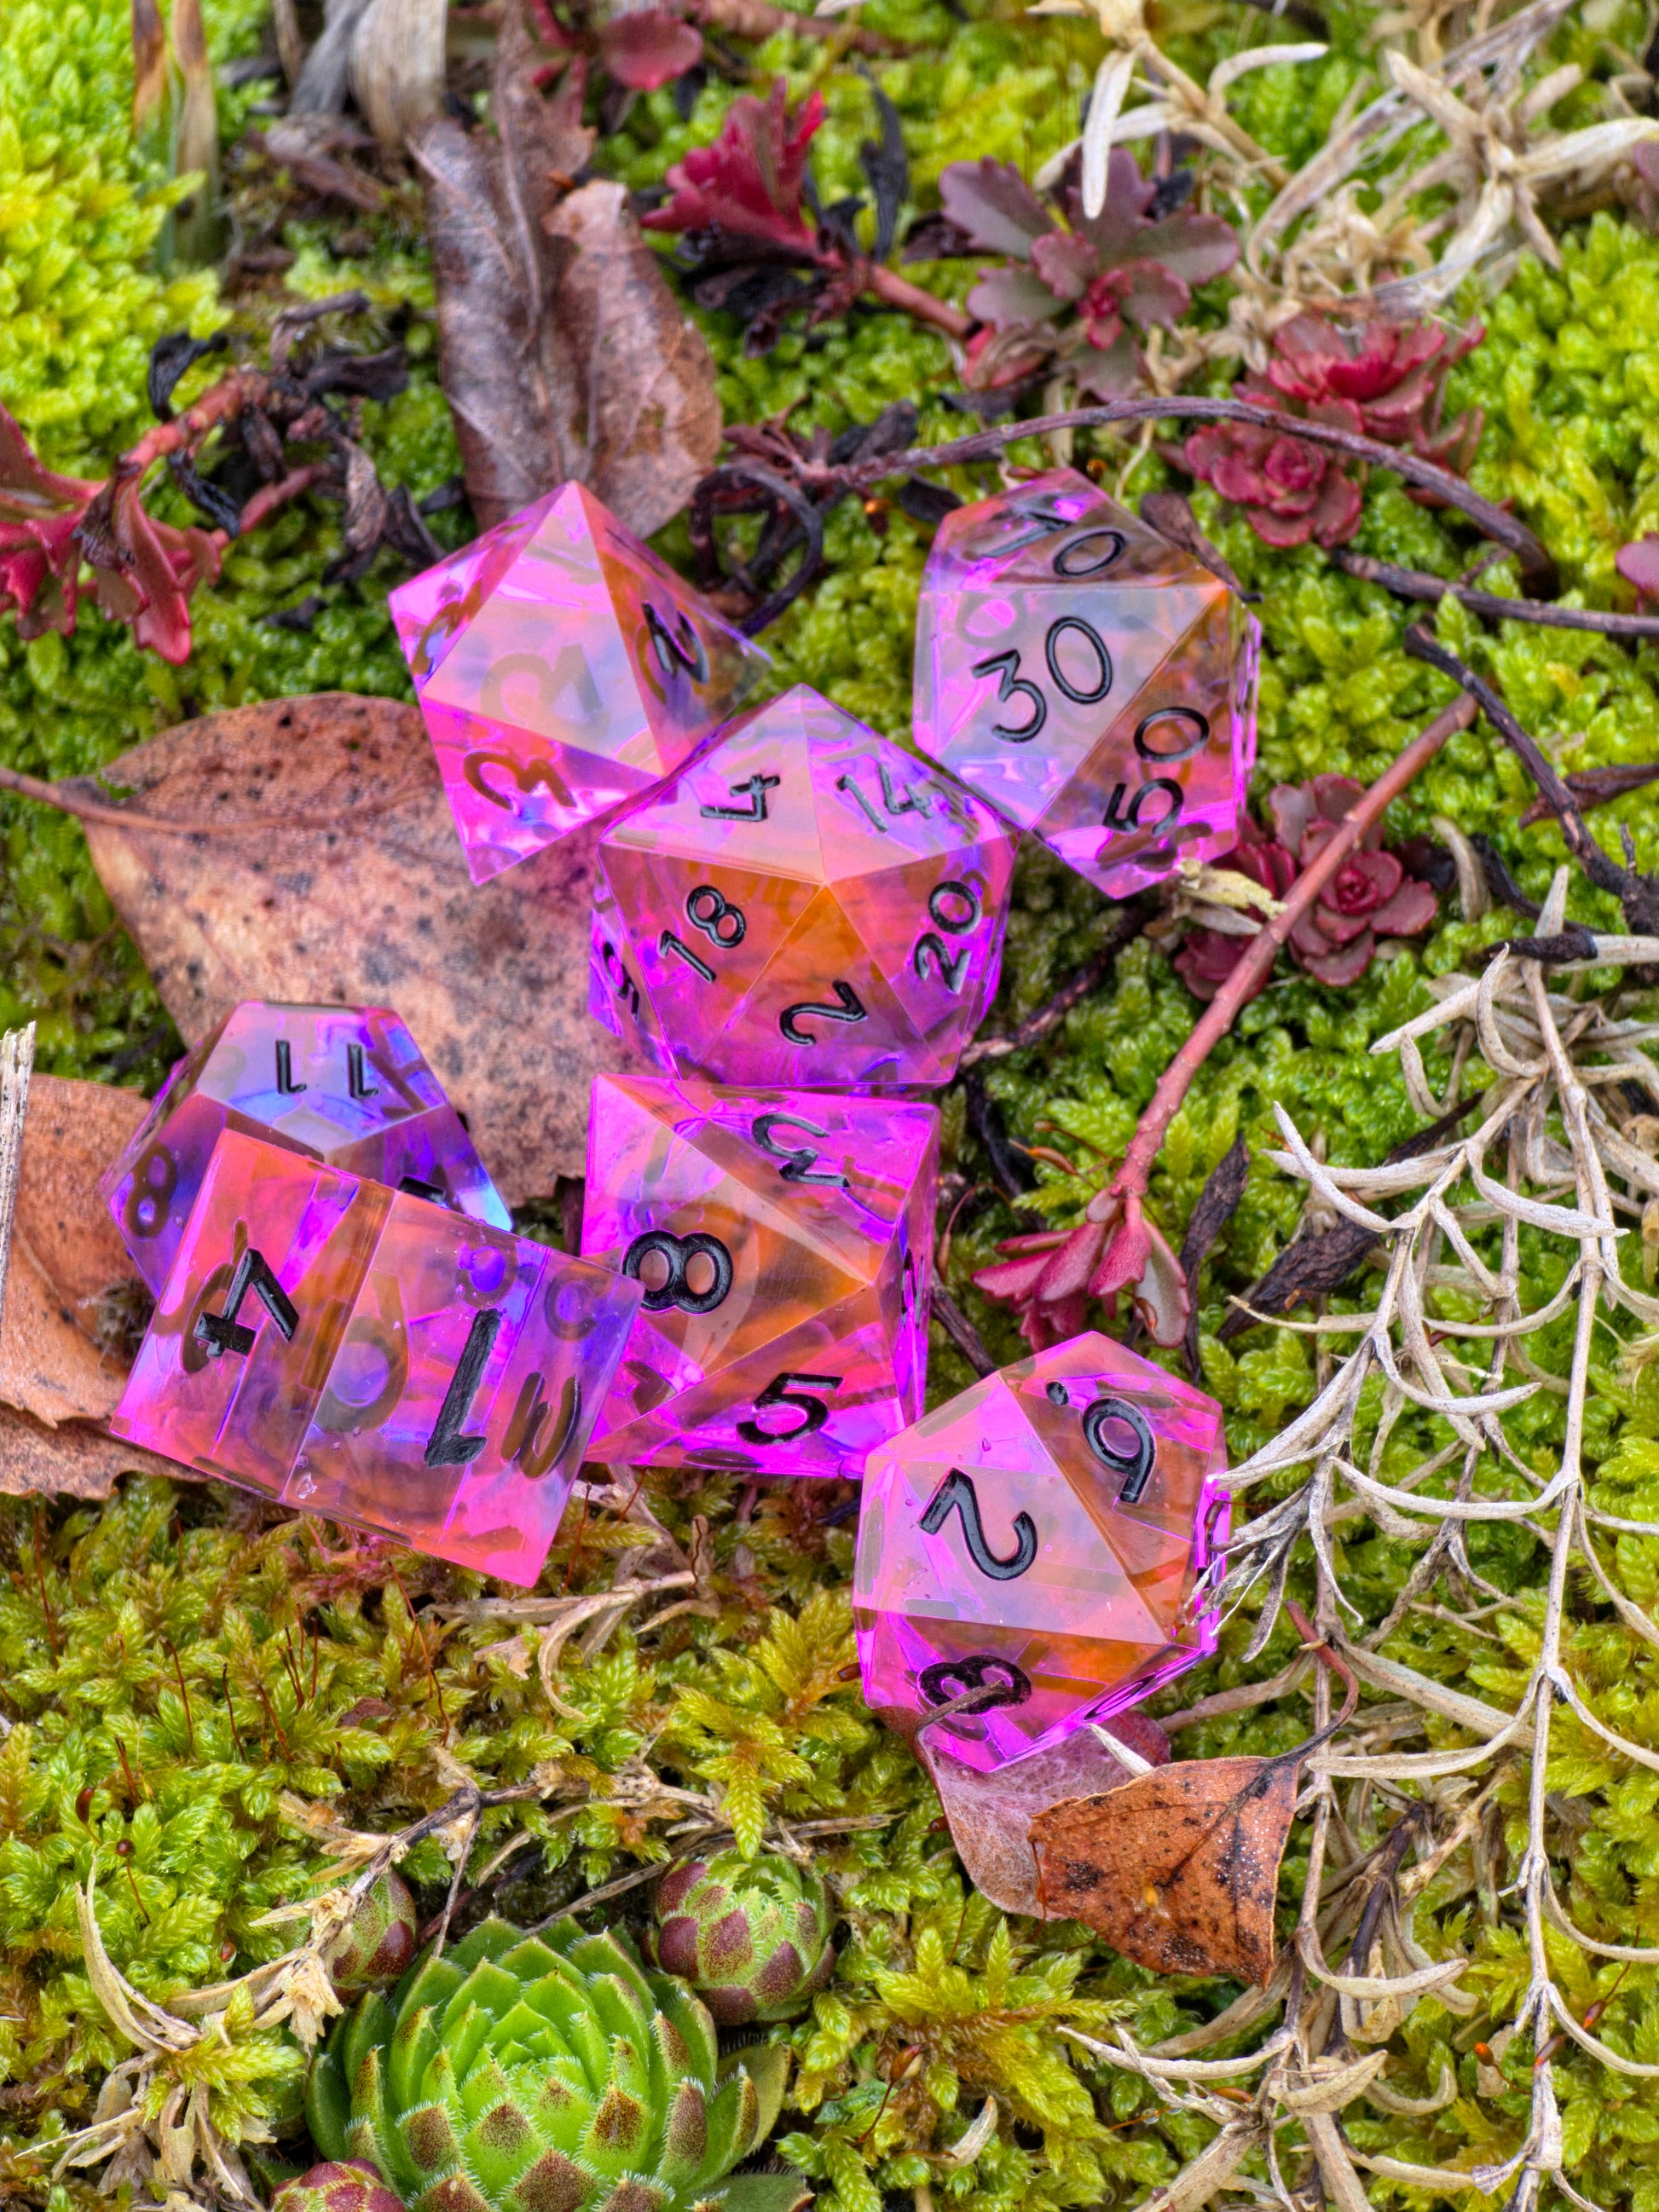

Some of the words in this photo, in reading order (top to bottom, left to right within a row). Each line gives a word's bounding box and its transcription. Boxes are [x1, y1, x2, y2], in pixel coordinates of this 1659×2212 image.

[970, 615, 1113, 744] 30
[699, 774, 781, 823] 4
[836, 762, 934, 833] 14
[1102, 707, 1210, 836] 50
[659, 884, 747, 984] 18
[913, 880, 982, 994] 20
[778, 979, 869, 1047] 2
[750, 1112, 851, 1188] 3
[193, 1248, 300, 1358] 4
[621, 1228, 734, 1316] 8
[735, 1372, 845, 1446] 5
[916, 1466, 1038, 1581] 2
[916, 1655, 1033, 1716] 8
